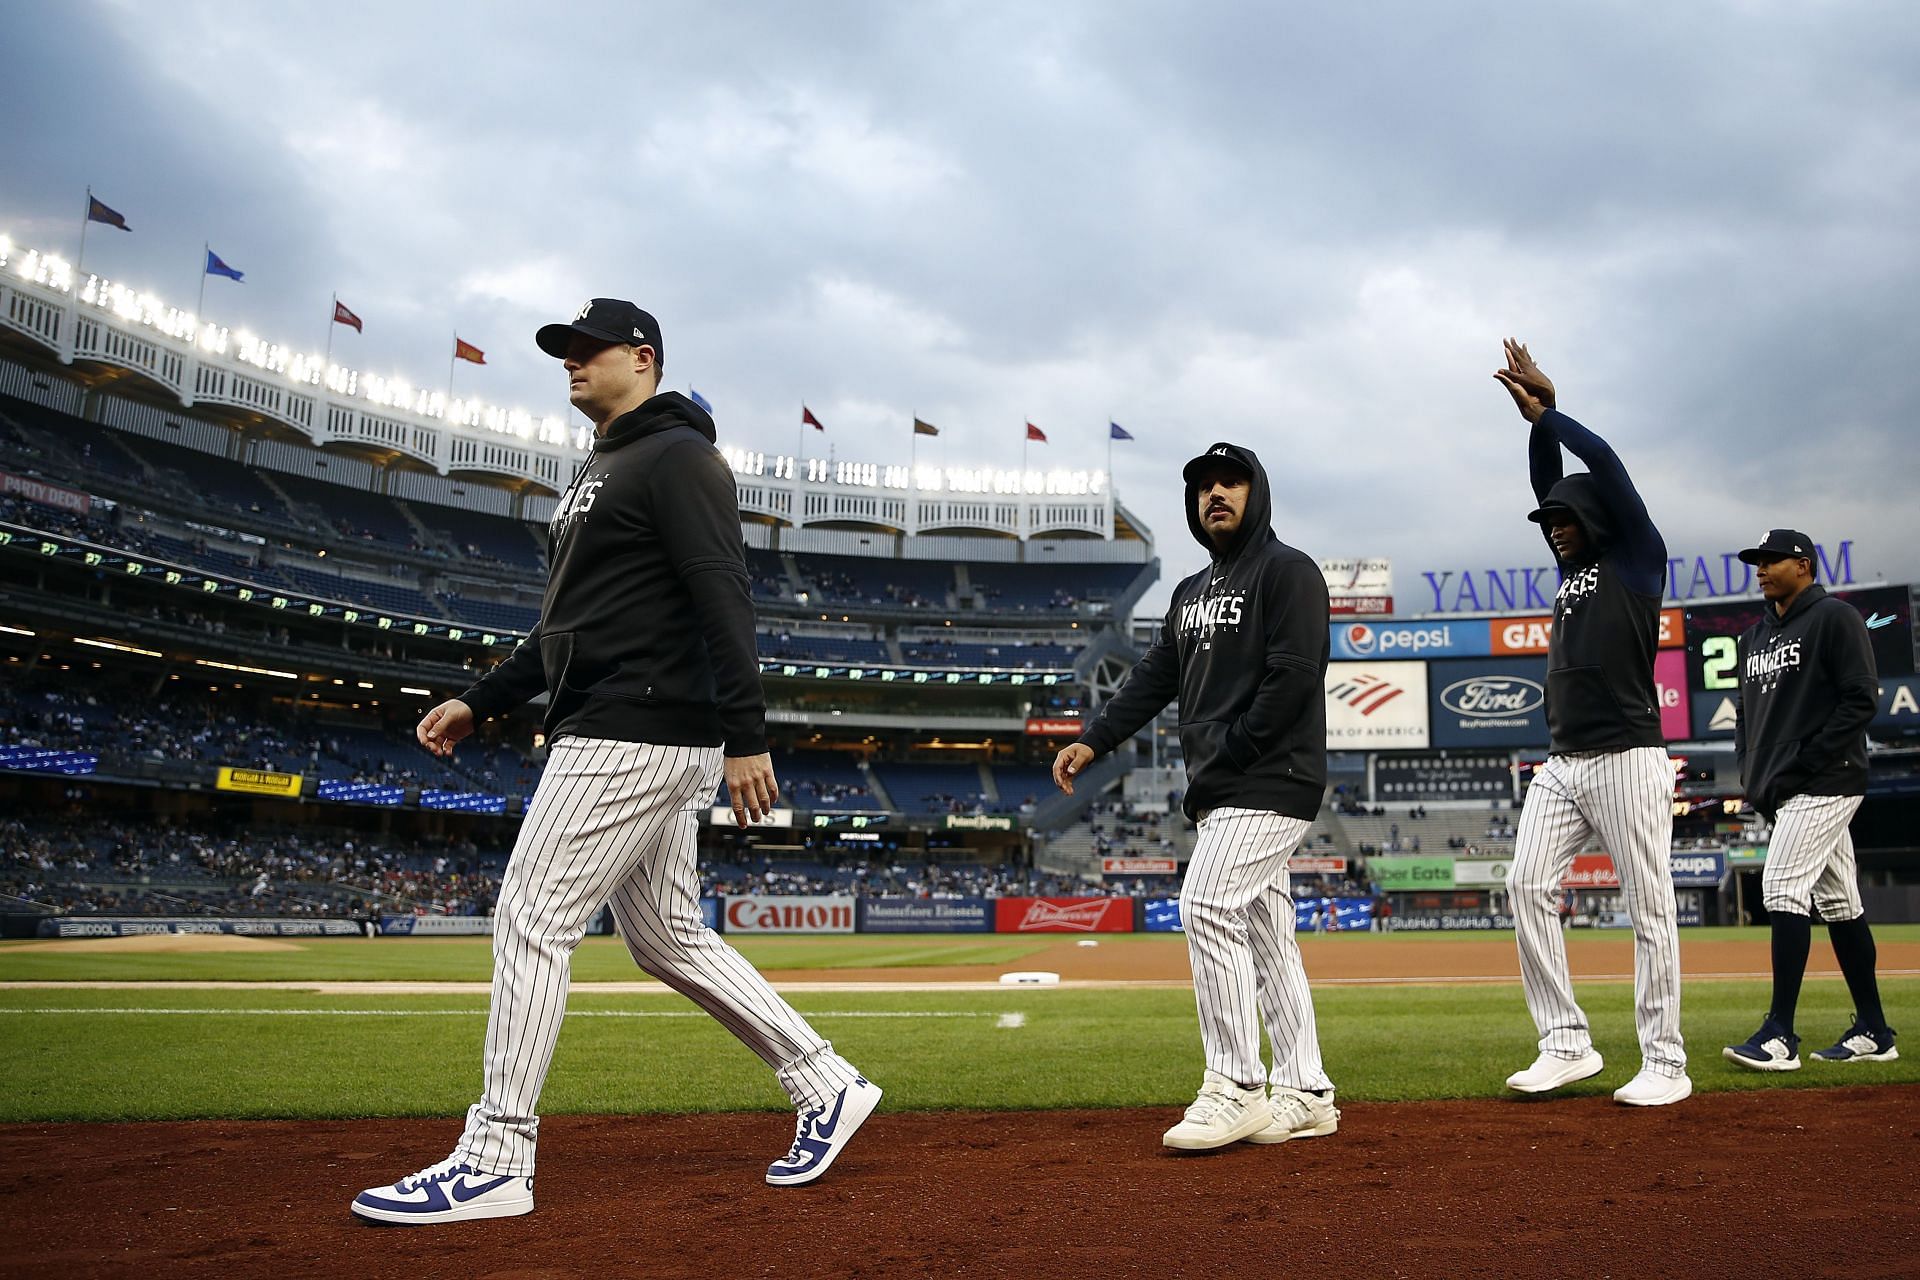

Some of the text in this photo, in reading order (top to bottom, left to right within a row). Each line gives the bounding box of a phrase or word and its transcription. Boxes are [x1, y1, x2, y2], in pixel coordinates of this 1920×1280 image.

[4, 476, 83, 510] PARTY DECK
[41, 543, 59, 556] 27
[85, 552, 102, 567] 27
[127, 562, 143, 576] 27
[166, 571, 182, 585] 27
[203, 581, 219, 594] 27
[238, 589, 254, 602] 27
[1379, 626, 1451, 652] pepsi
[1746, 643, 1801, 678] YANKEES
[1459, 681, 1528, 710] Ford
[1346, 728, 1362, 737] OF
[1366, 727, 1424, 737] AMERICA
[1459, 719, 1529, 729] BuyFordNow.com
[1412, 867, 1451, 881] Eats
[727, 900, 851, 928] Canon
[936, 904, 984, 917] Einstein
[1391, 915, 1439, 930] StubHub
[1443, 915, 1492, 930] StubHub
